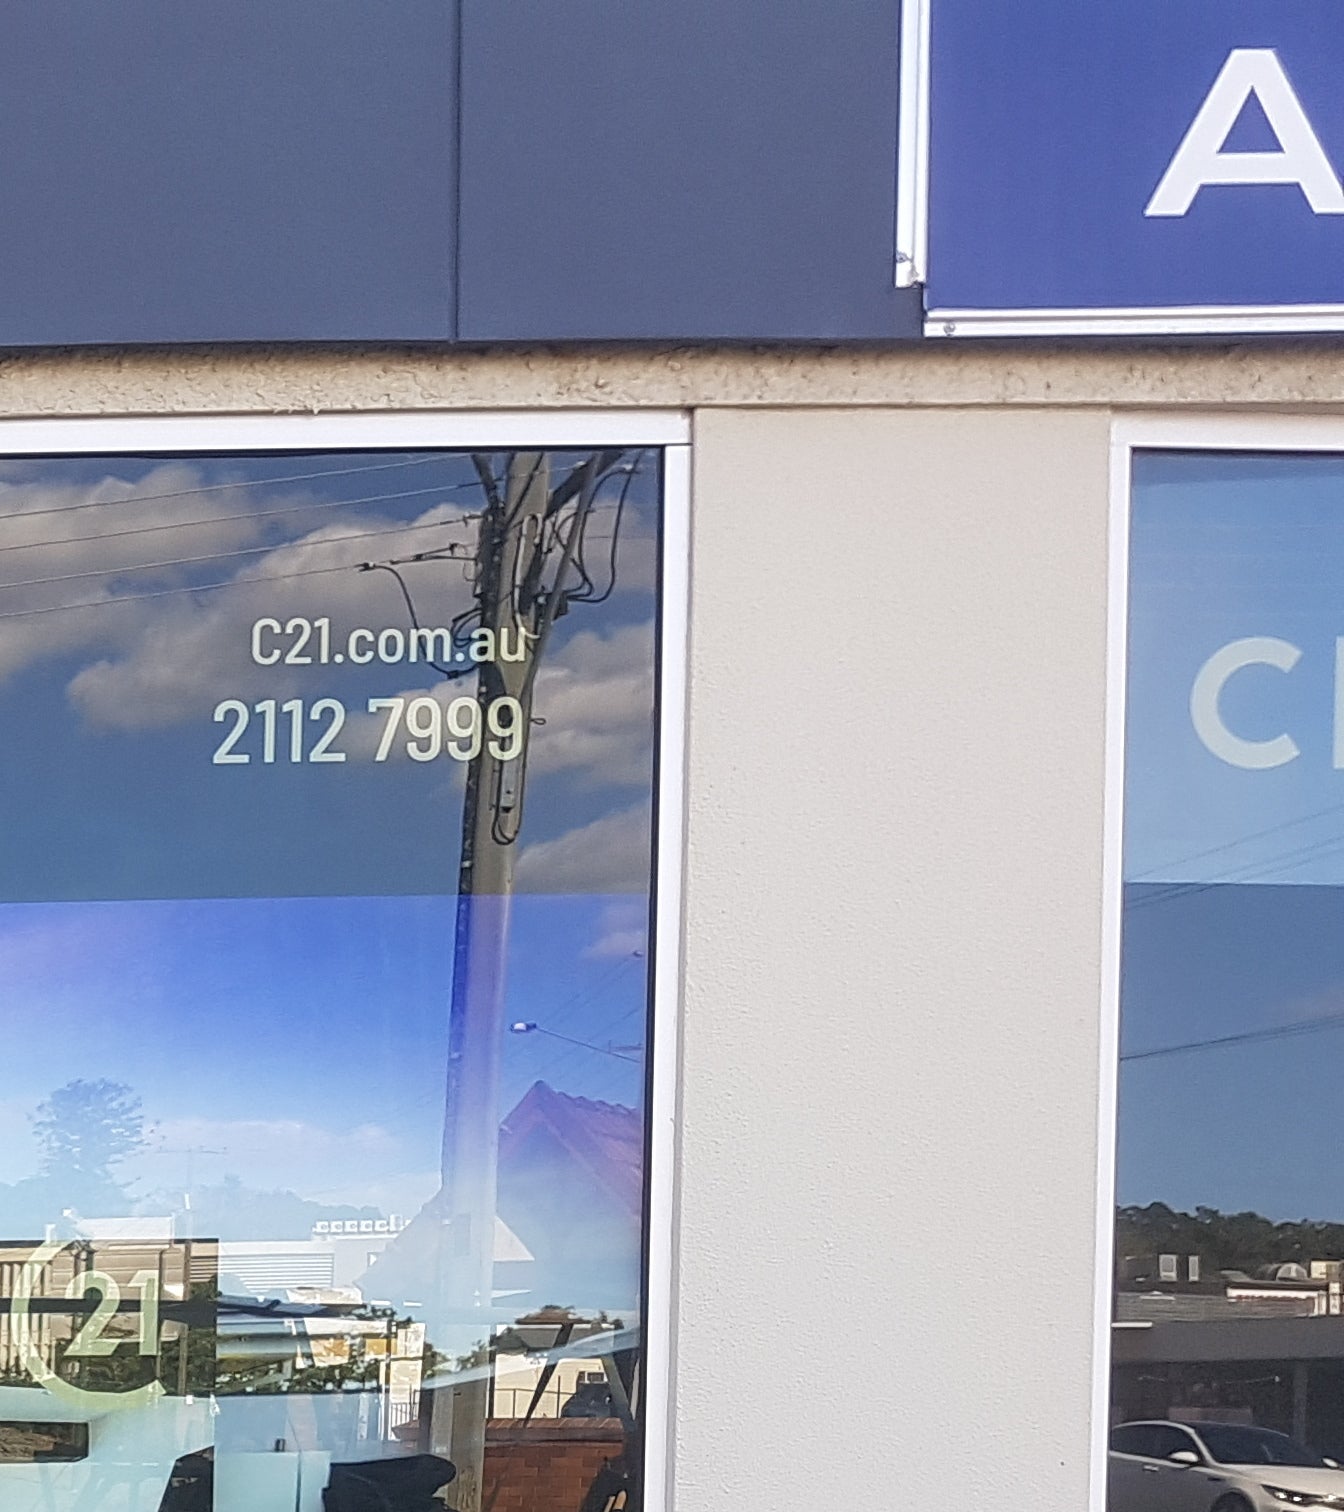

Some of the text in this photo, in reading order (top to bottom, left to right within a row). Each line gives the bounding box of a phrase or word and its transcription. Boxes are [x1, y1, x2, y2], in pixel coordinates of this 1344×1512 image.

[250, 618, 528, 668] C21.com.au
[211, 696, 524, 768] 2112 7999
